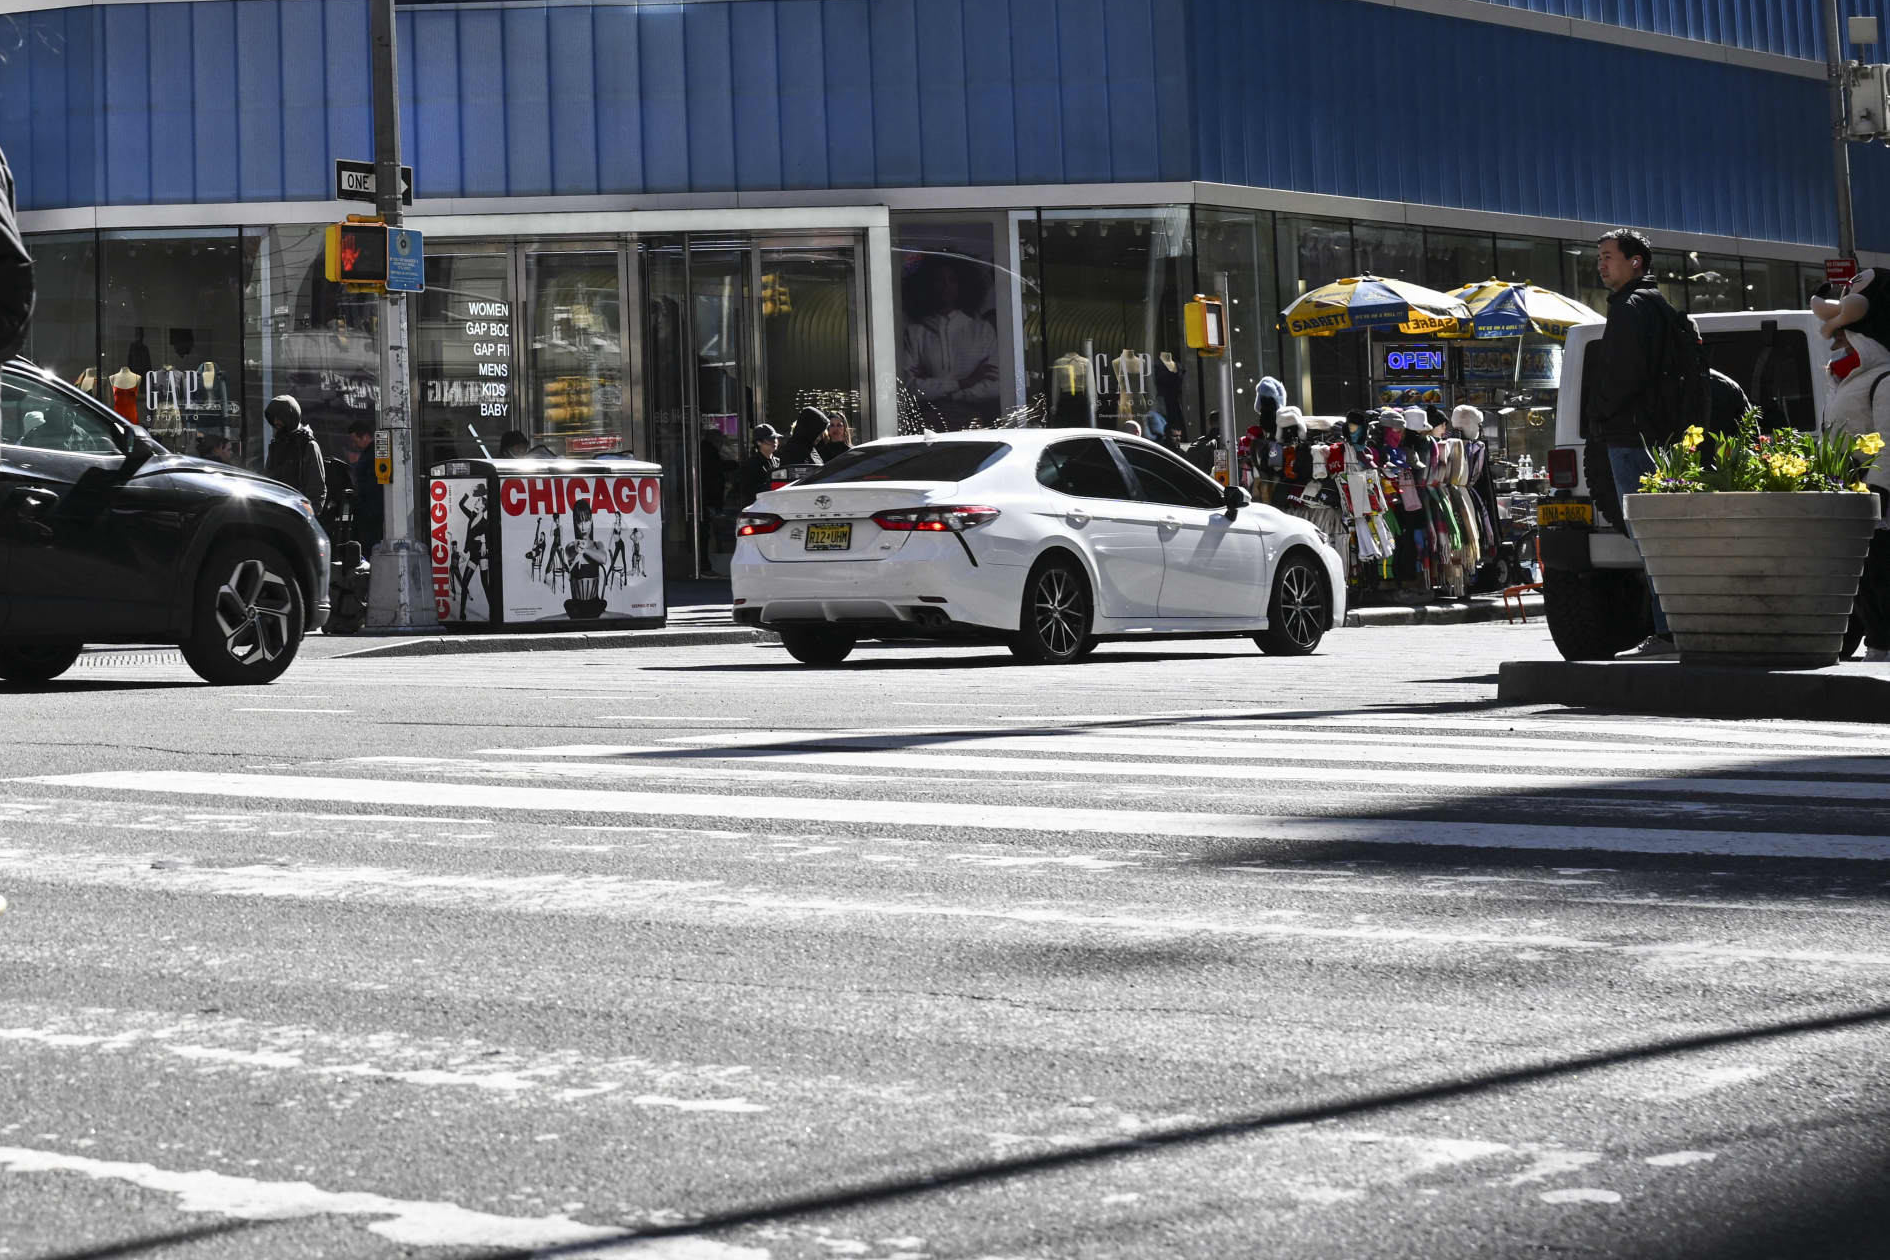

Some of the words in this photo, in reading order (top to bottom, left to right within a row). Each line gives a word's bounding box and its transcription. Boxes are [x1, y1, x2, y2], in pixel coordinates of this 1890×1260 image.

[347, 173, 369, 190] ONE
[468, 302, 509, 317] WOMEN
[466, 322, 488, 336] GAP
[1291, 313, 1348, 333] SABRETT
[473, 343, 495, 356] GAP
[1387, 351, 1442, 370] OPEN
[478, 363, 508, 377] MENS
[1095, 353, 1152, 395] GAP
[145, 370, 198, 411] GAP
[482, 383, 506, 397] KIDS
[480, 403, 508, 417] BABY
[500, 477, 661, 517] CHICAGO
[430, 480, 451, 621] CHICAGO
